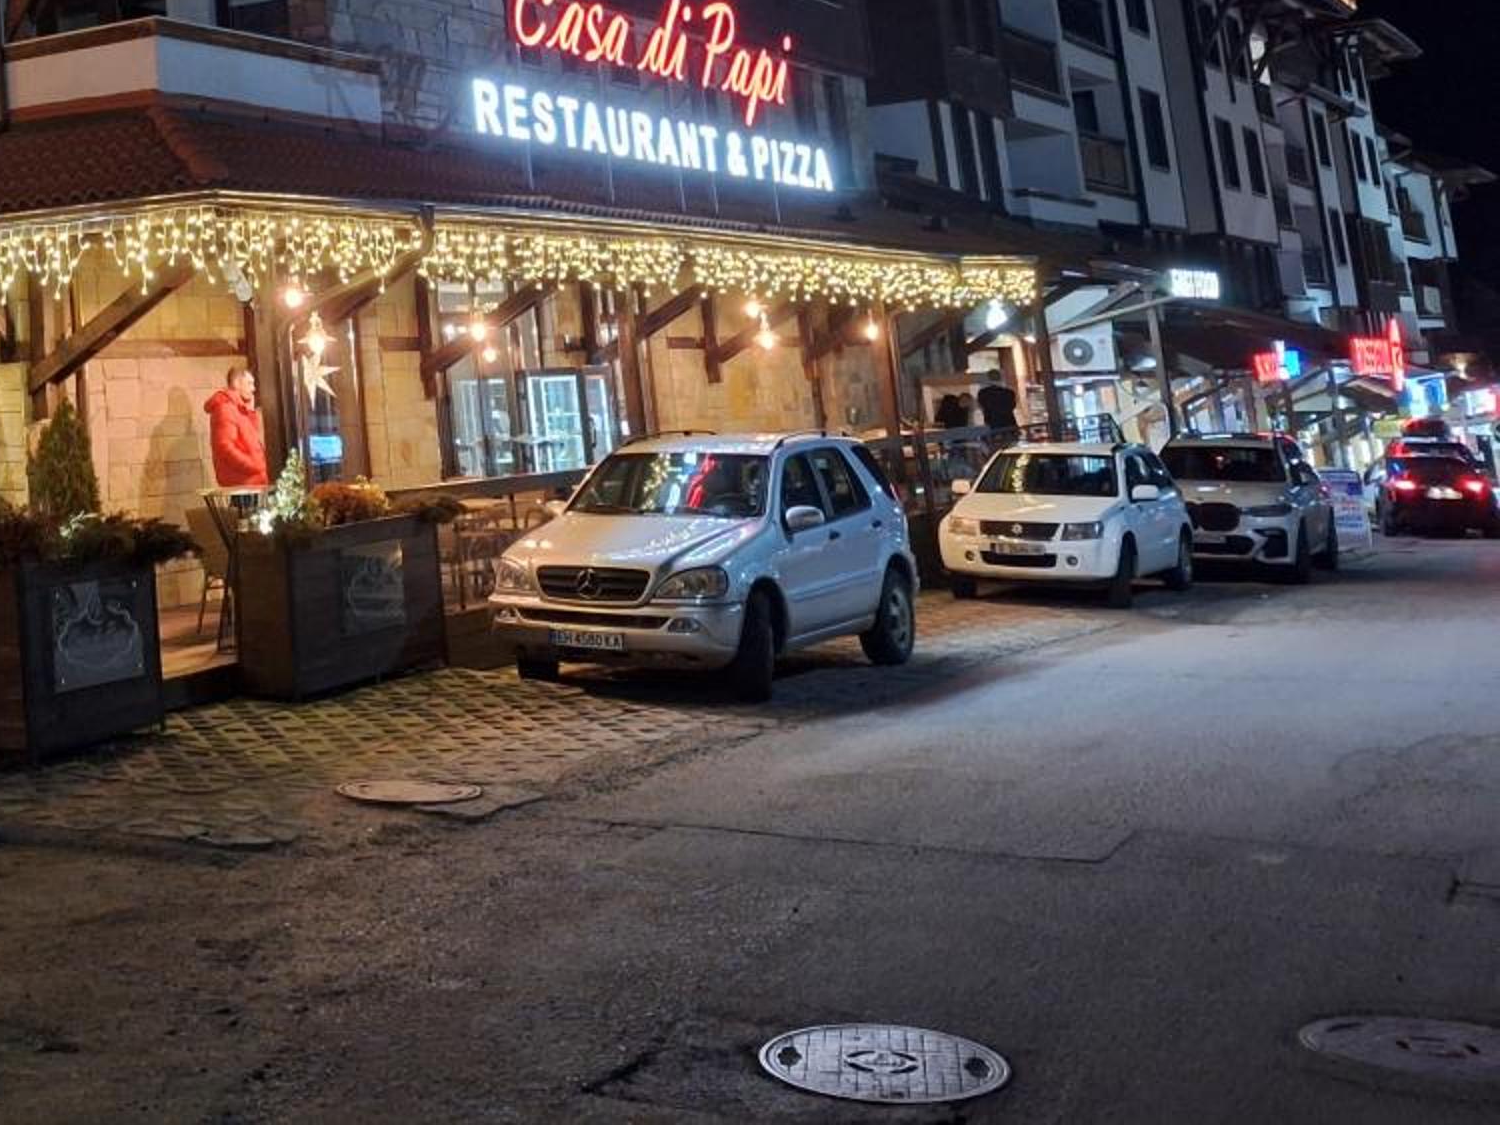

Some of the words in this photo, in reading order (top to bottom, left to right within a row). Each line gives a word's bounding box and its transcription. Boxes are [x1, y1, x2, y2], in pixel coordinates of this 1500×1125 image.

[702, 2, 792, 126] Papi
[471, 78, 719, 172] RESTAURANT
[726, 130, 749, 178] &
[751, 137, 836, 192] PIZZA
